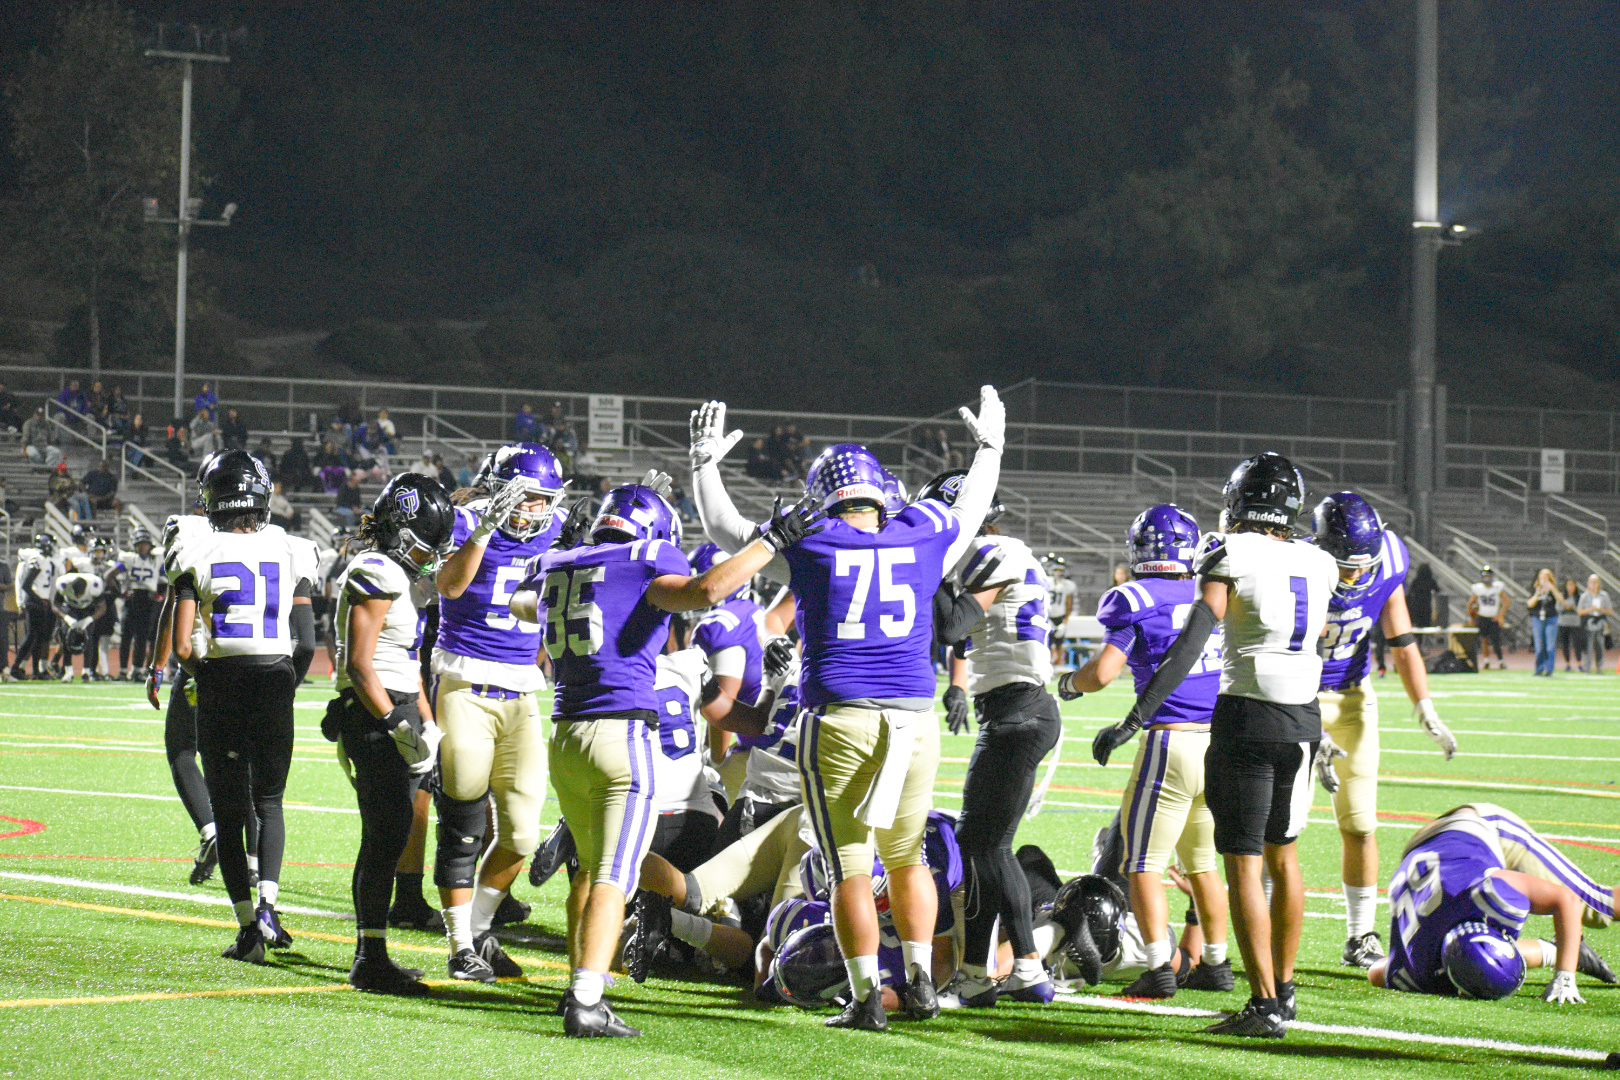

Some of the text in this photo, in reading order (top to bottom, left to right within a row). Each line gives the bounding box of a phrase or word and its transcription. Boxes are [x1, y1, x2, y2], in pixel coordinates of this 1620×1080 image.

[218, 498, 254, 510] Riddell
[837, 487, 877, 498] Ridde
[1247, 510, 1288, 525] Riddell
[1143, 563, 1176, 571] Riddell
[211, 562, 280, 638] 21
[485, 566, 541, 633] 5
[835, 547, 916, 639] 75
[1290, 575, 1308, 651] 1
